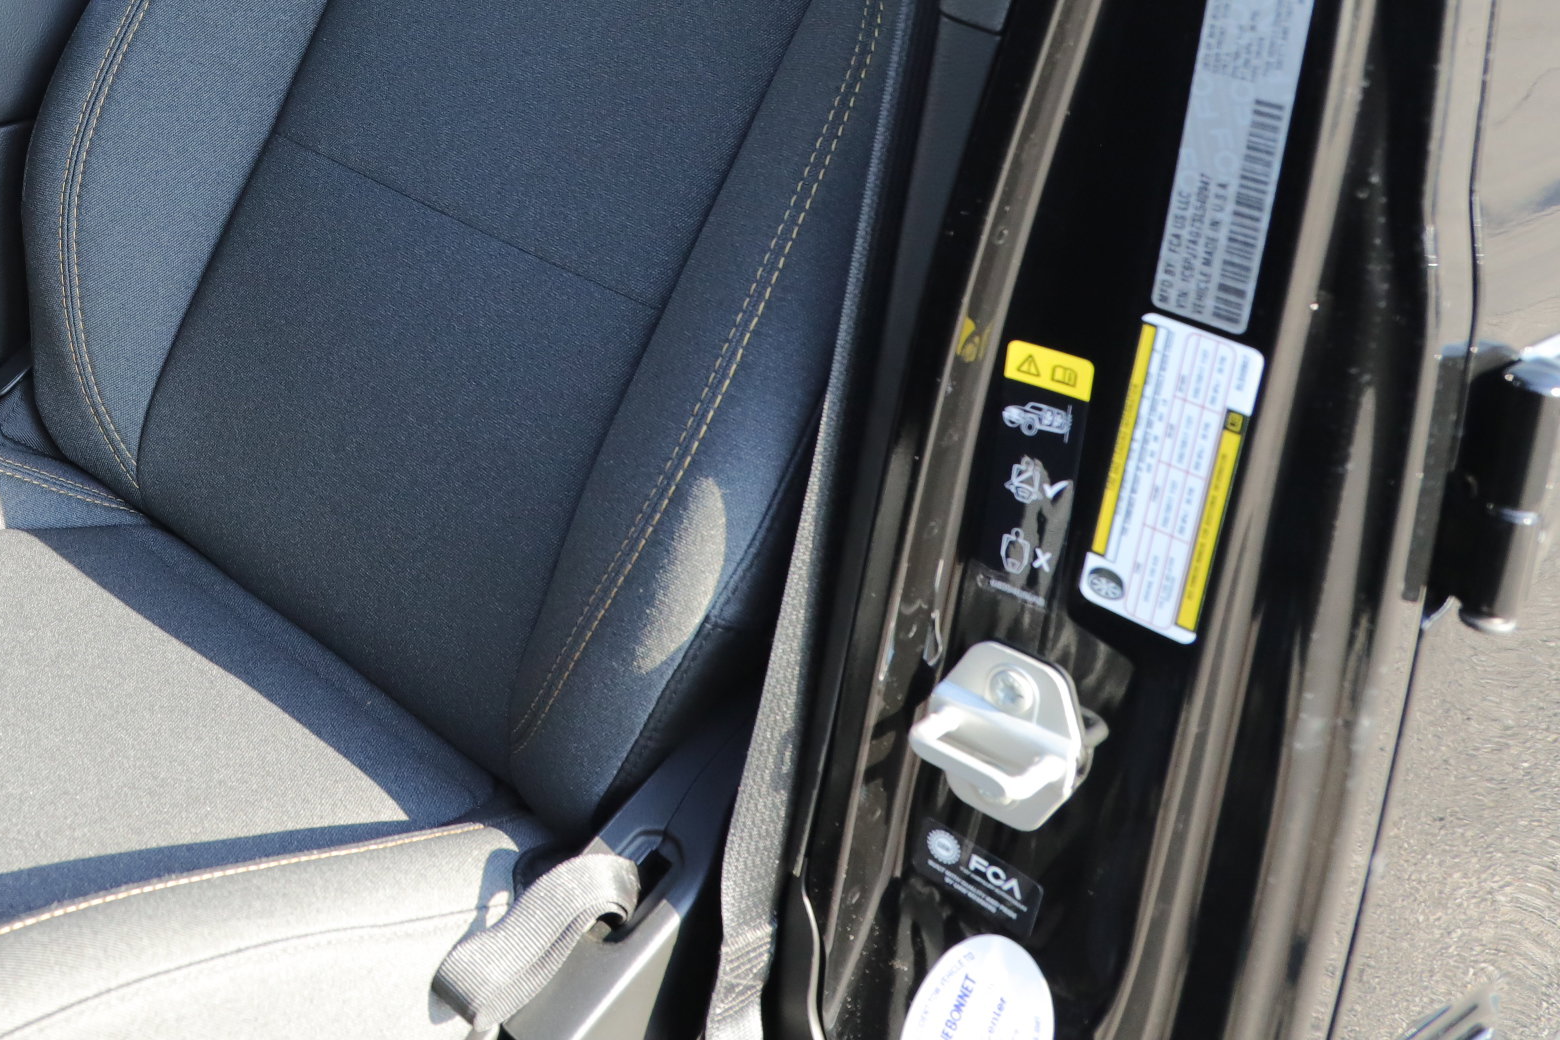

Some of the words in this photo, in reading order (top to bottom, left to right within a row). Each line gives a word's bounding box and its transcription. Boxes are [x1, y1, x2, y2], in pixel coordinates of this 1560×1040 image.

[1168, 233, 1181, 253] FCA
[1202, 236, 1219, 267] MADE
[968, 853, 1022, 901] FCA
